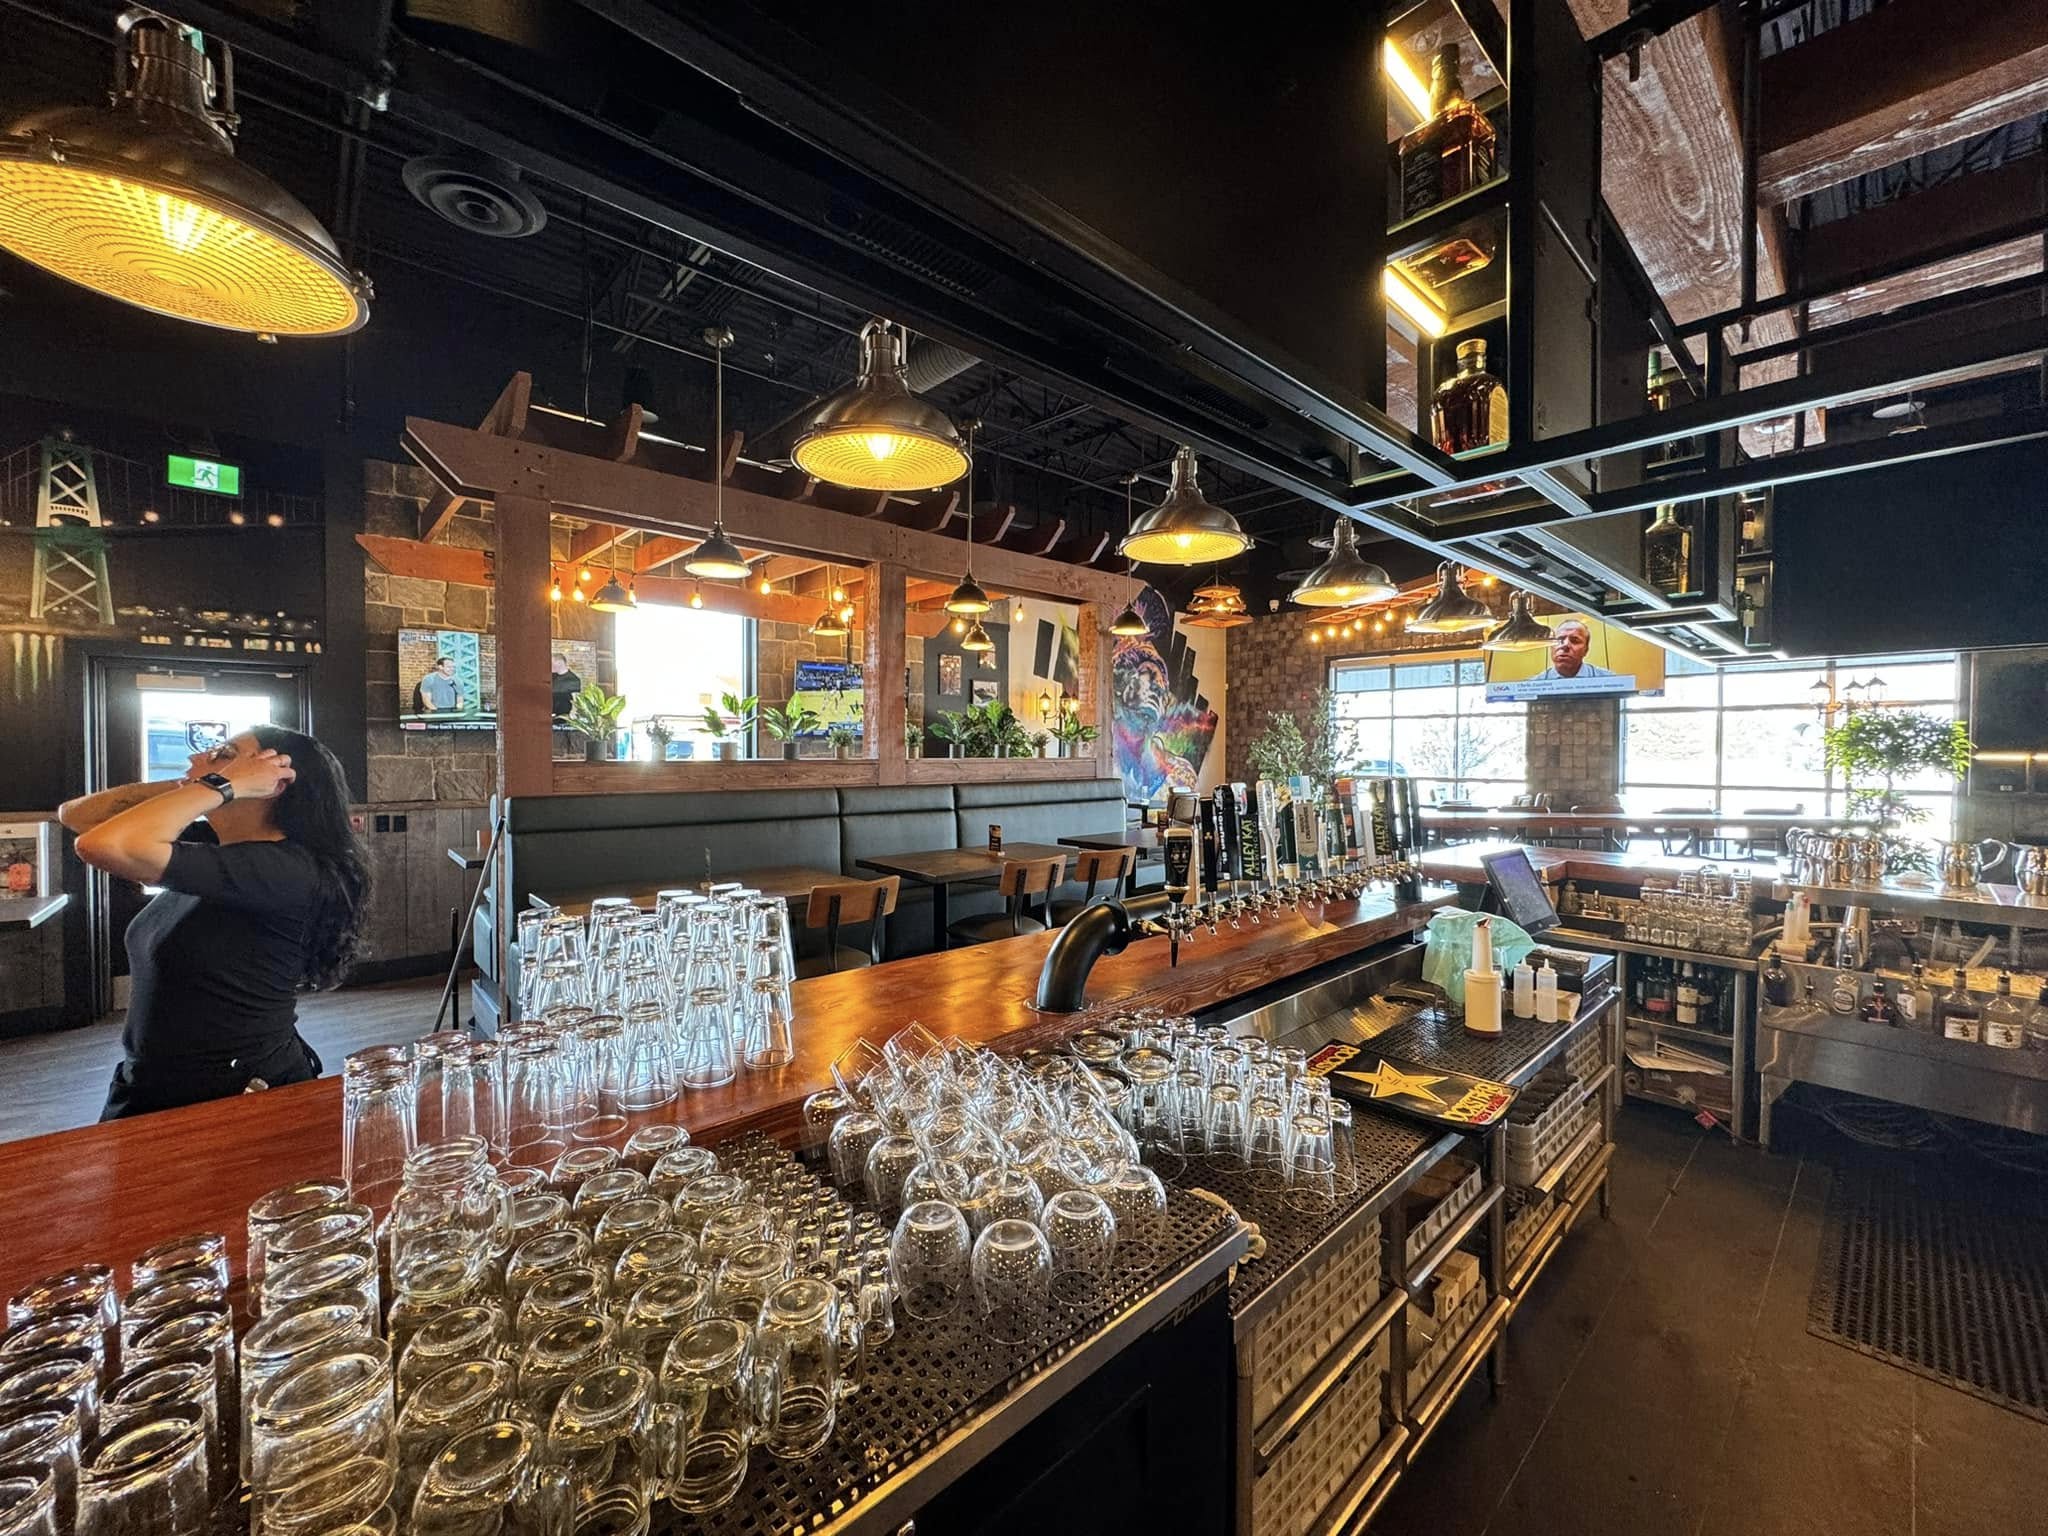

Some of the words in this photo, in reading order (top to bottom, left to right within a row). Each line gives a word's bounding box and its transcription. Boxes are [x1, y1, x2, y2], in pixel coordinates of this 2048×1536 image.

[1374, 806, 1384, 821] KAT
[1241, 819, 1253, 840] KAT
[1375, 824, 1386, 852] ALLEY
[1243, 842, 1255, 876] ALLEY
[1444, 1082, 1503, 1121] OCKSTAR
